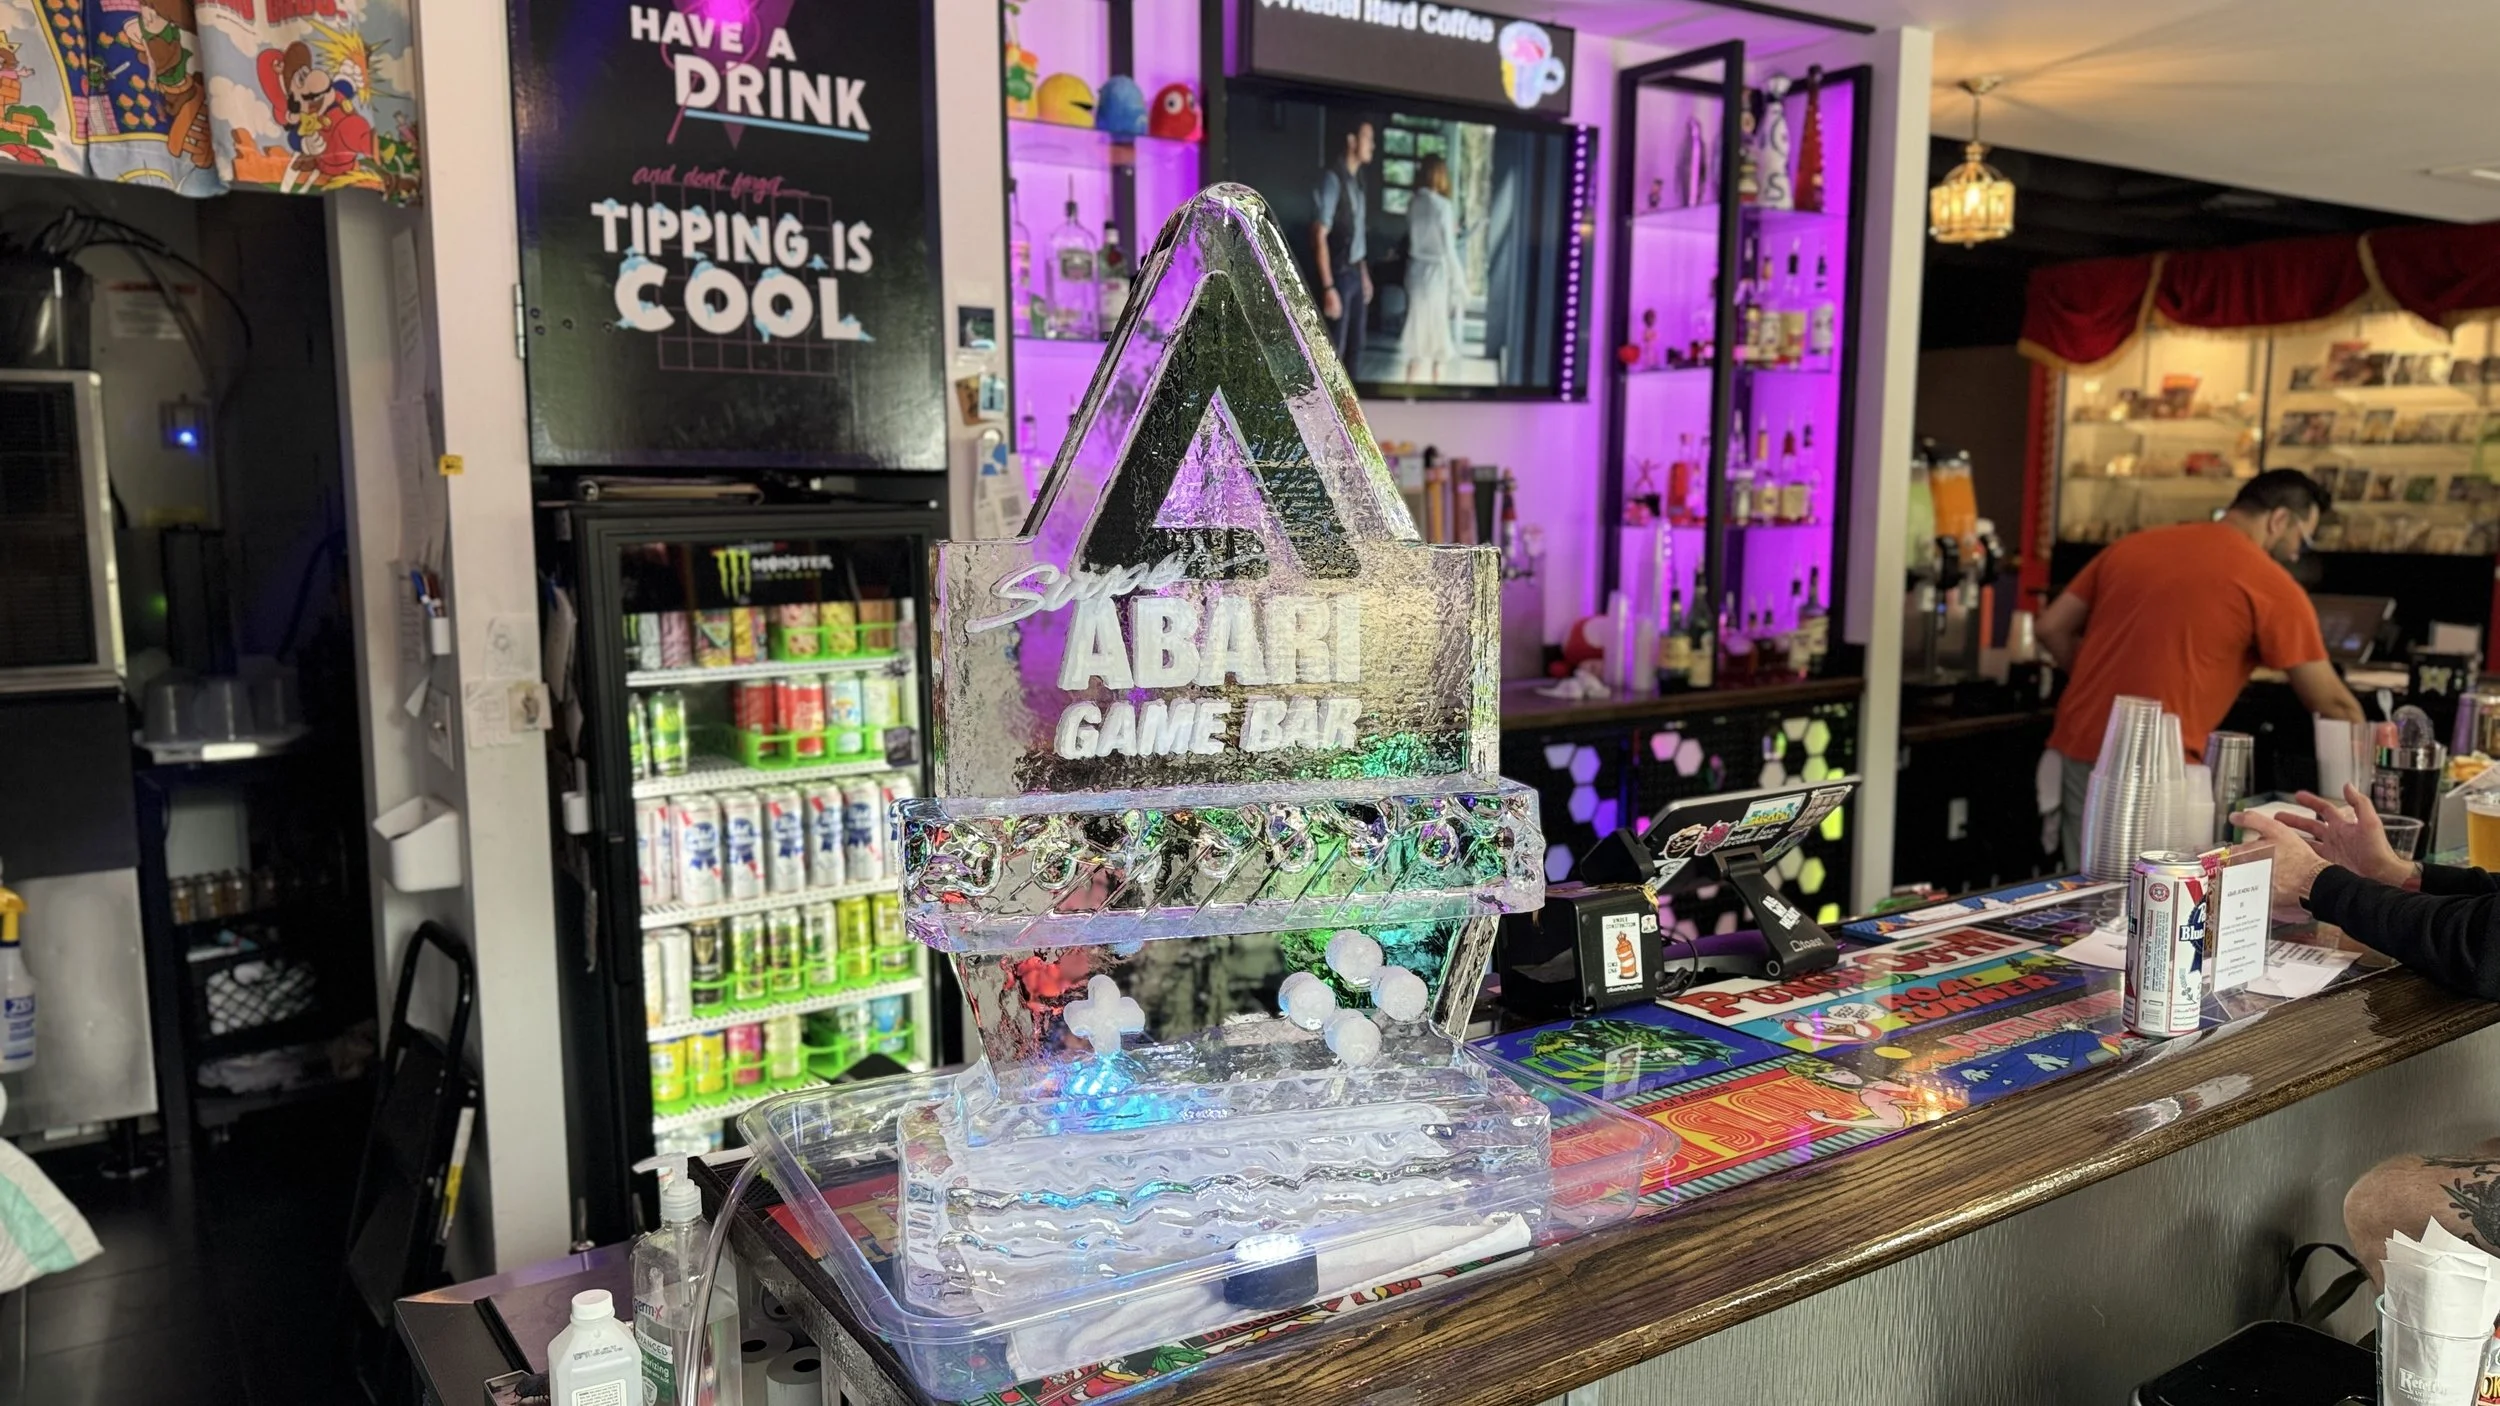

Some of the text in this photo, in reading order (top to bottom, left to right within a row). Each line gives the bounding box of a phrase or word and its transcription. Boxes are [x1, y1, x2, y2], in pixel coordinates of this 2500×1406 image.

[630, 5, 796, 62] HAVE A
[1420, 4, 1495, 43] Coffee
[674, 54, 871, 131] DRINK
[632, 164, 676, 185] and
[591, 201, 873, 273] TIPPING IS
[614, 262, 866, 341] COOL
[1057, 593, 1363, 690] ABARI
[1053, 697, 1365, 760] GAME BAR
[1800, 937, 1825, 950] toast
[1890, 974, 2061, 1026] RUNNER
[1664, 1096, 1679, 1111] of
[1681, 1085, 1732, 1105] America
[637, 1331, 668, 1356] DVANCED
